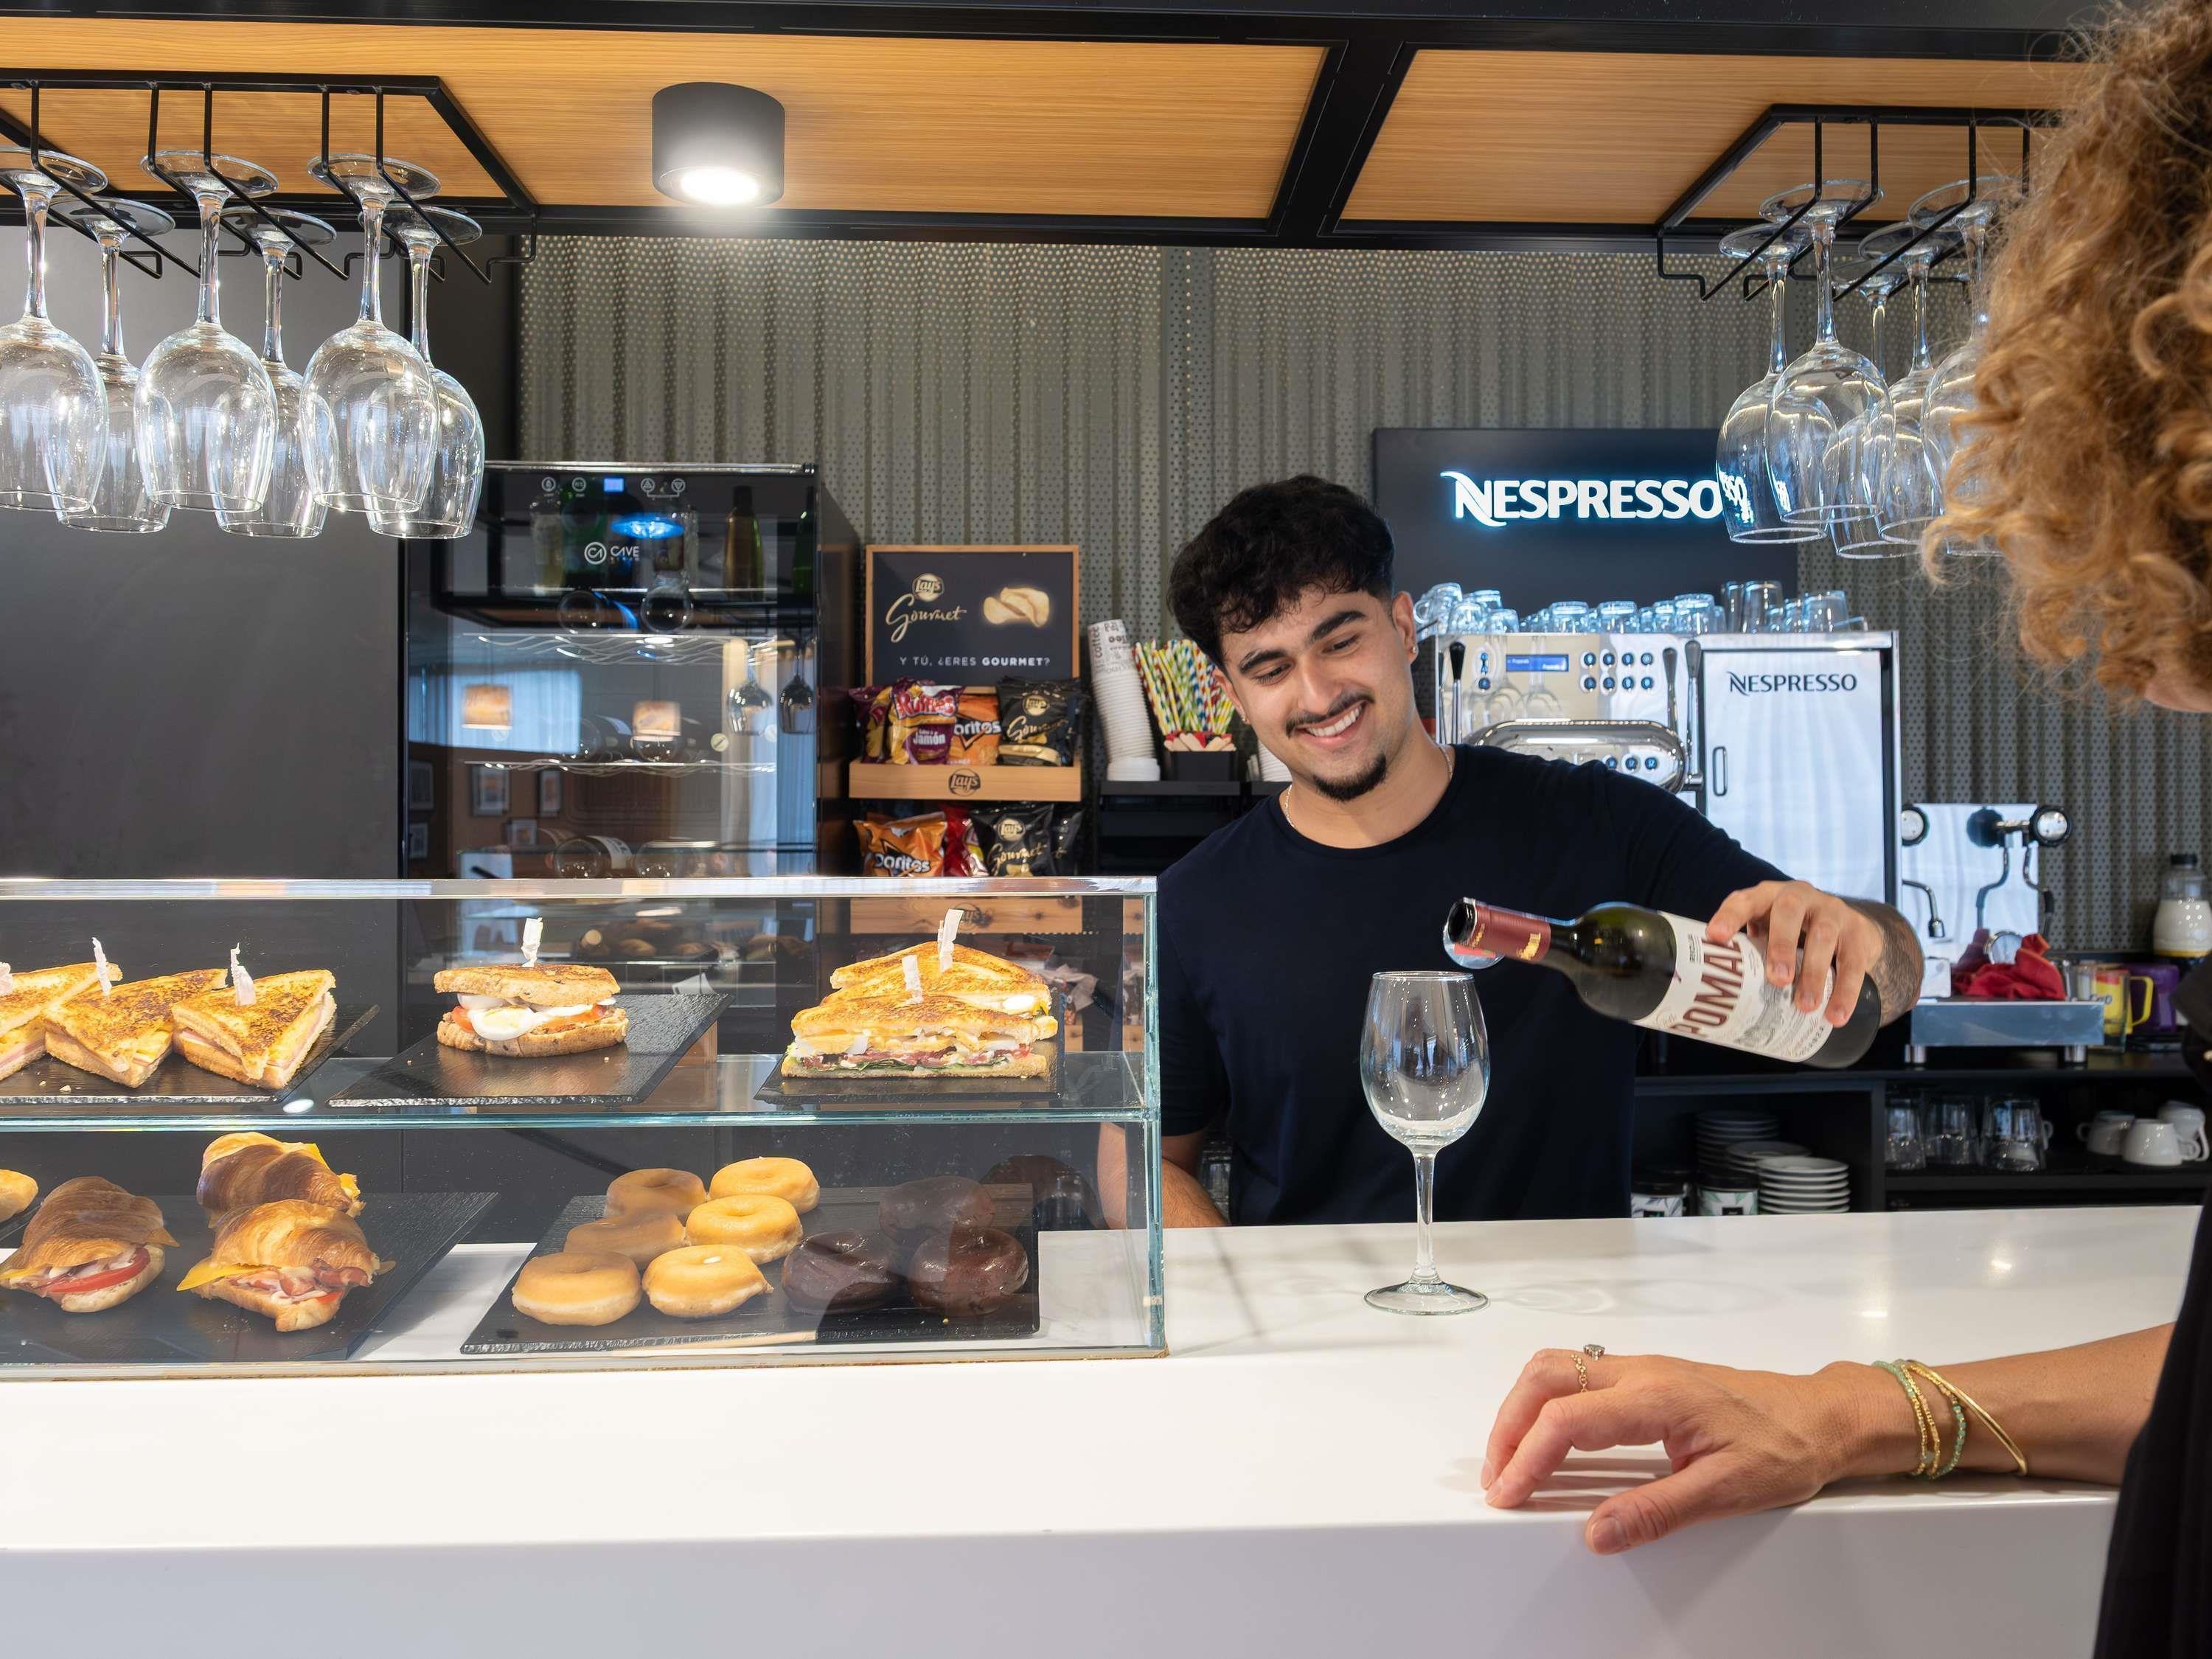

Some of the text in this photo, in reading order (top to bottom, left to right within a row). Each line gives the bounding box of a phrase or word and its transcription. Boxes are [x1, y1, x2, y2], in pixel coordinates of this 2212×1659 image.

[1440, 470, 1723, 527] NESPRESSO
[611, 546, 639, 557] CAVE
[886, 594, 967, 643] Gourmet
[900, 657, 907, 665] Y
[938, 656, 976, 666] ¿ERES
[981, 656, 1050, 666] GOURMET?
[1726, 671, 1857, 696] NESPRESSO
[954, 720, 1001, 735] oritos
[913, 731, 945, 745] Jamón
[874, 853, 931, 872] Doritos
[1669, 938, 1743, 1037] POMAL
